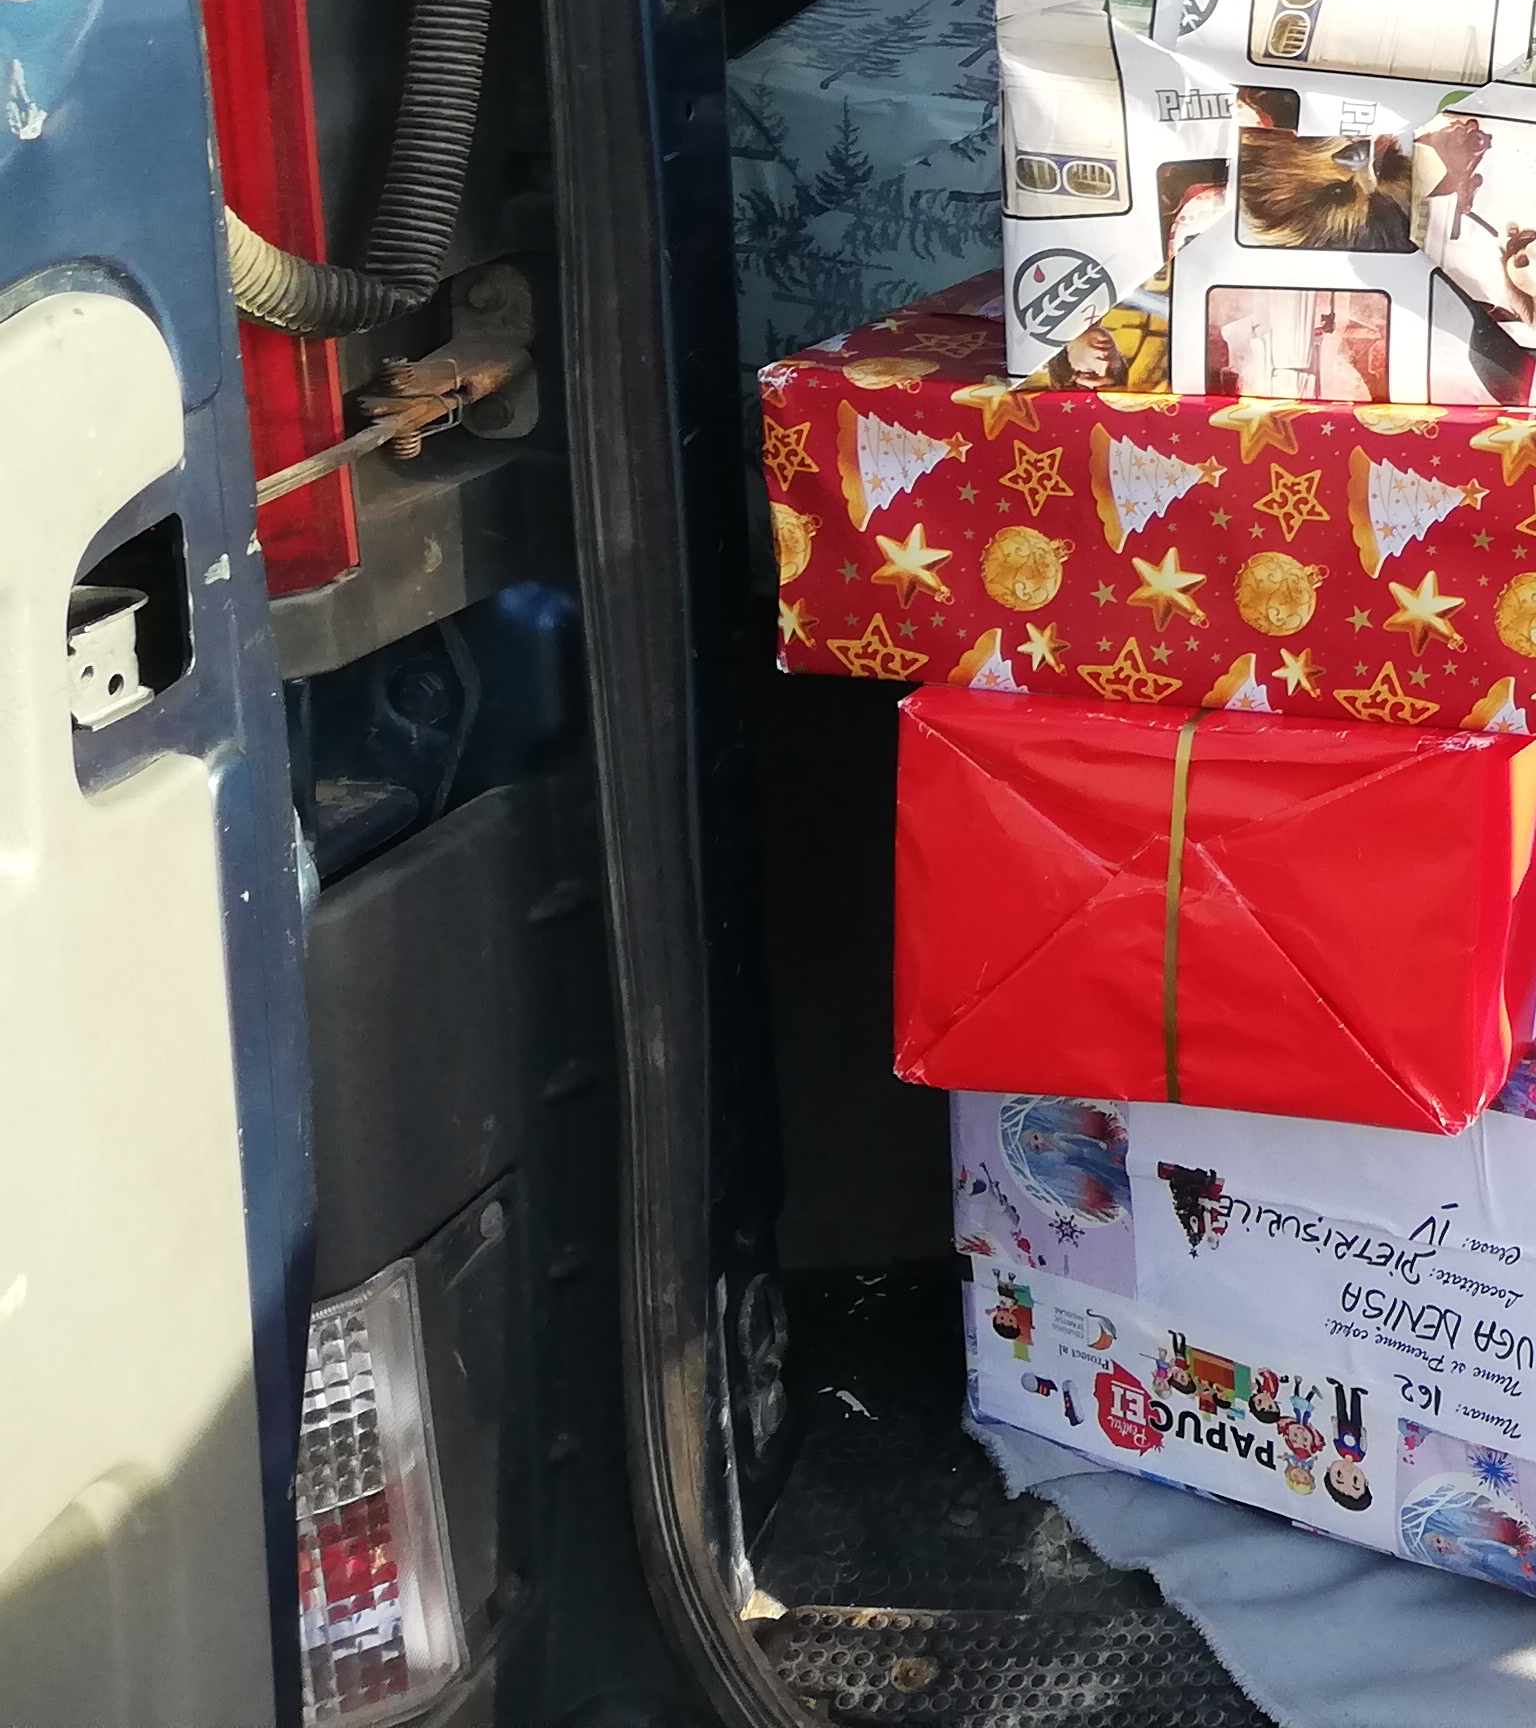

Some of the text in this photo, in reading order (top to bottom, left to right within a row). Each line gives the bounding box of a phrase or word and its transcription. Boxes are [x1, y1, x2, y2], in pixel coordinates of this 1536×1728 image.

[1462, 1235, 1522, 1265] Clasa:
[1341, 1280, 1463, 1351] DENISA
[1430, 1266, 1524, 1309] Localitate:
[1070, 1345, 1110, 1370] Proiect
[1323, 1317, 1522, 1398] Nume si Prenume copil:
[1110, 1382, 1276, 1470] PAPUCEI
[1393, 1373, 1522, 1441] Numar: 162
